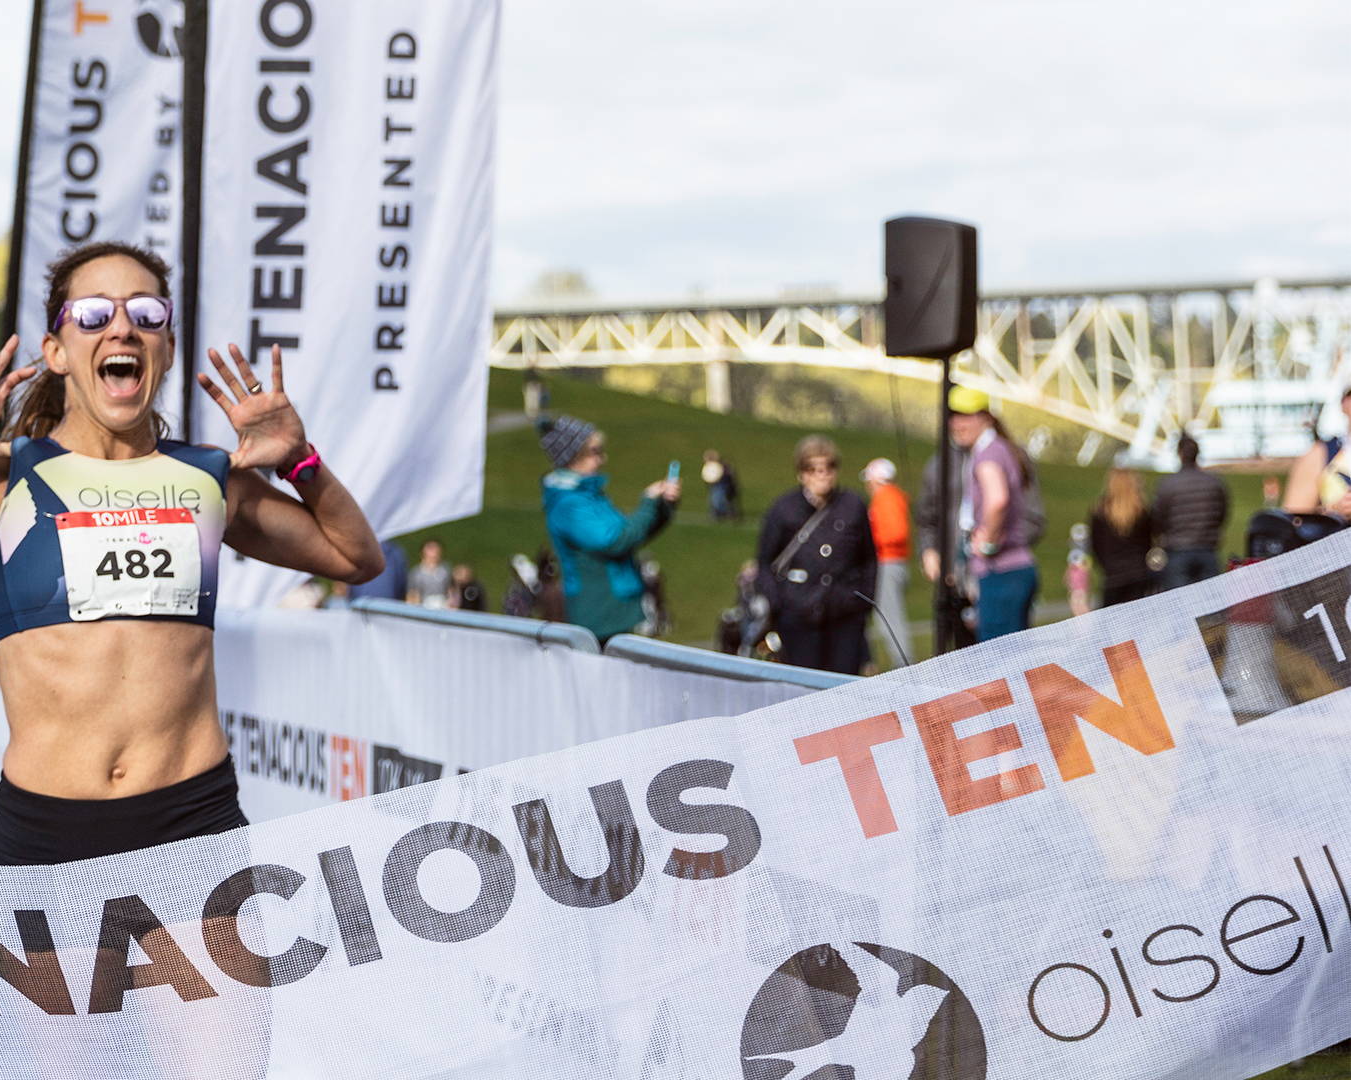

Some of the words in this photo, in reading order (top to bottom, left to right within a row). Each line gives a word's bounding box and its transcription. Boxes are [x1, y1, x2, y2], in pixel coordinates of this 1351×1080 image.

[374, 31, 418, 392] PRESENTED
[78, 484, 202, 512] oiselle
[95, 548, 175, 581] 482
[240, 712, 328, 797] TENACIOUS
[329, 733, 368, 802] TEN
[792, 639, 1176, 839] TEN
